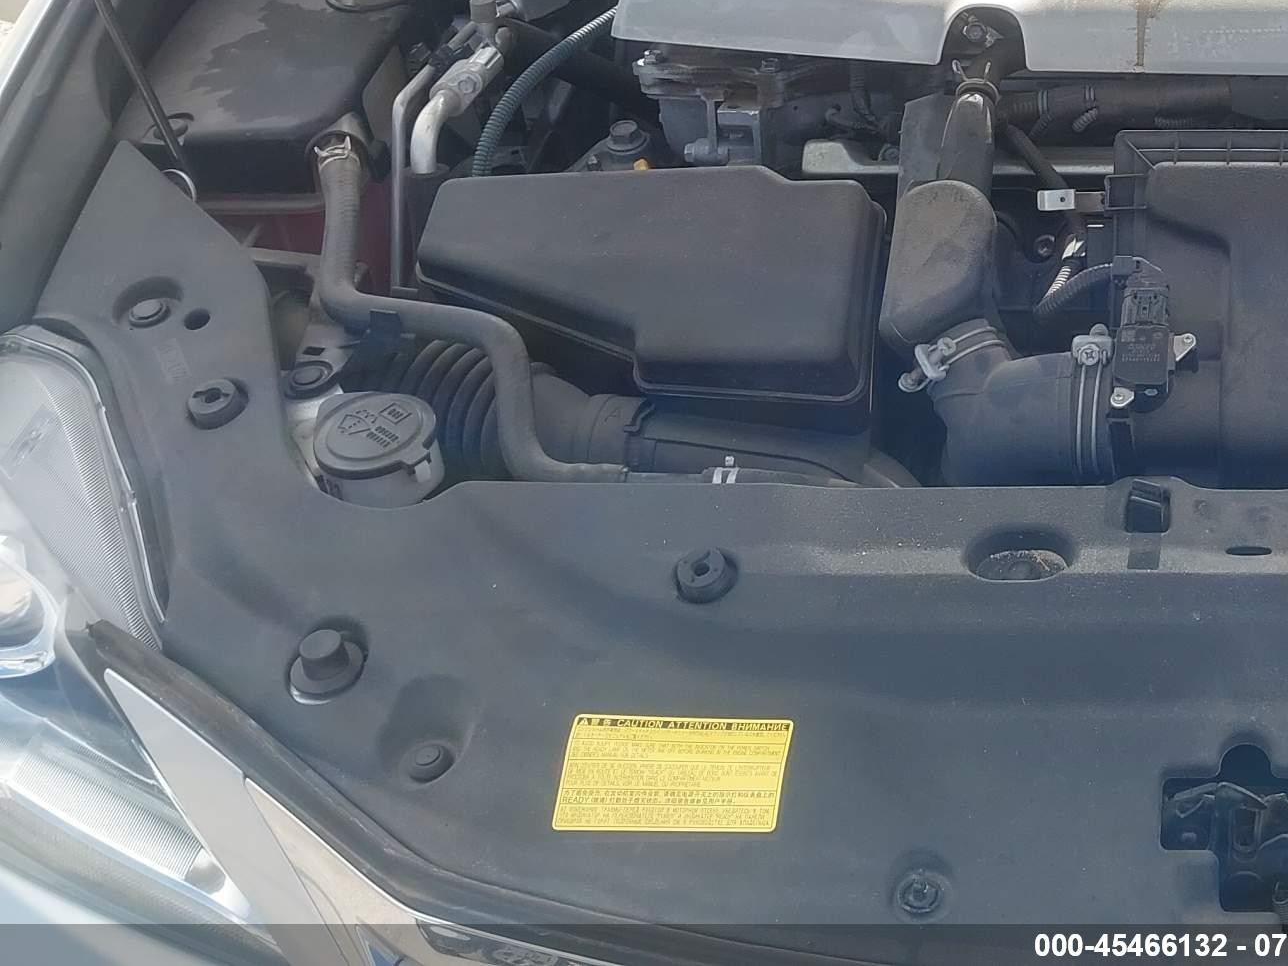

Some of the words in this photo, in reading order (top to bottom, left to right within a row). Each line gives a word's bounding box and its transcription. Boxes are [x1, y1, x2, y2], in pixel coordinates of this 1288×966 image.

[616, 719, 663, 729] CAUTION
[667, 721, 727, 730] ATTENTION
[731, 722, 789, 732] ВНИМАНИЕ
